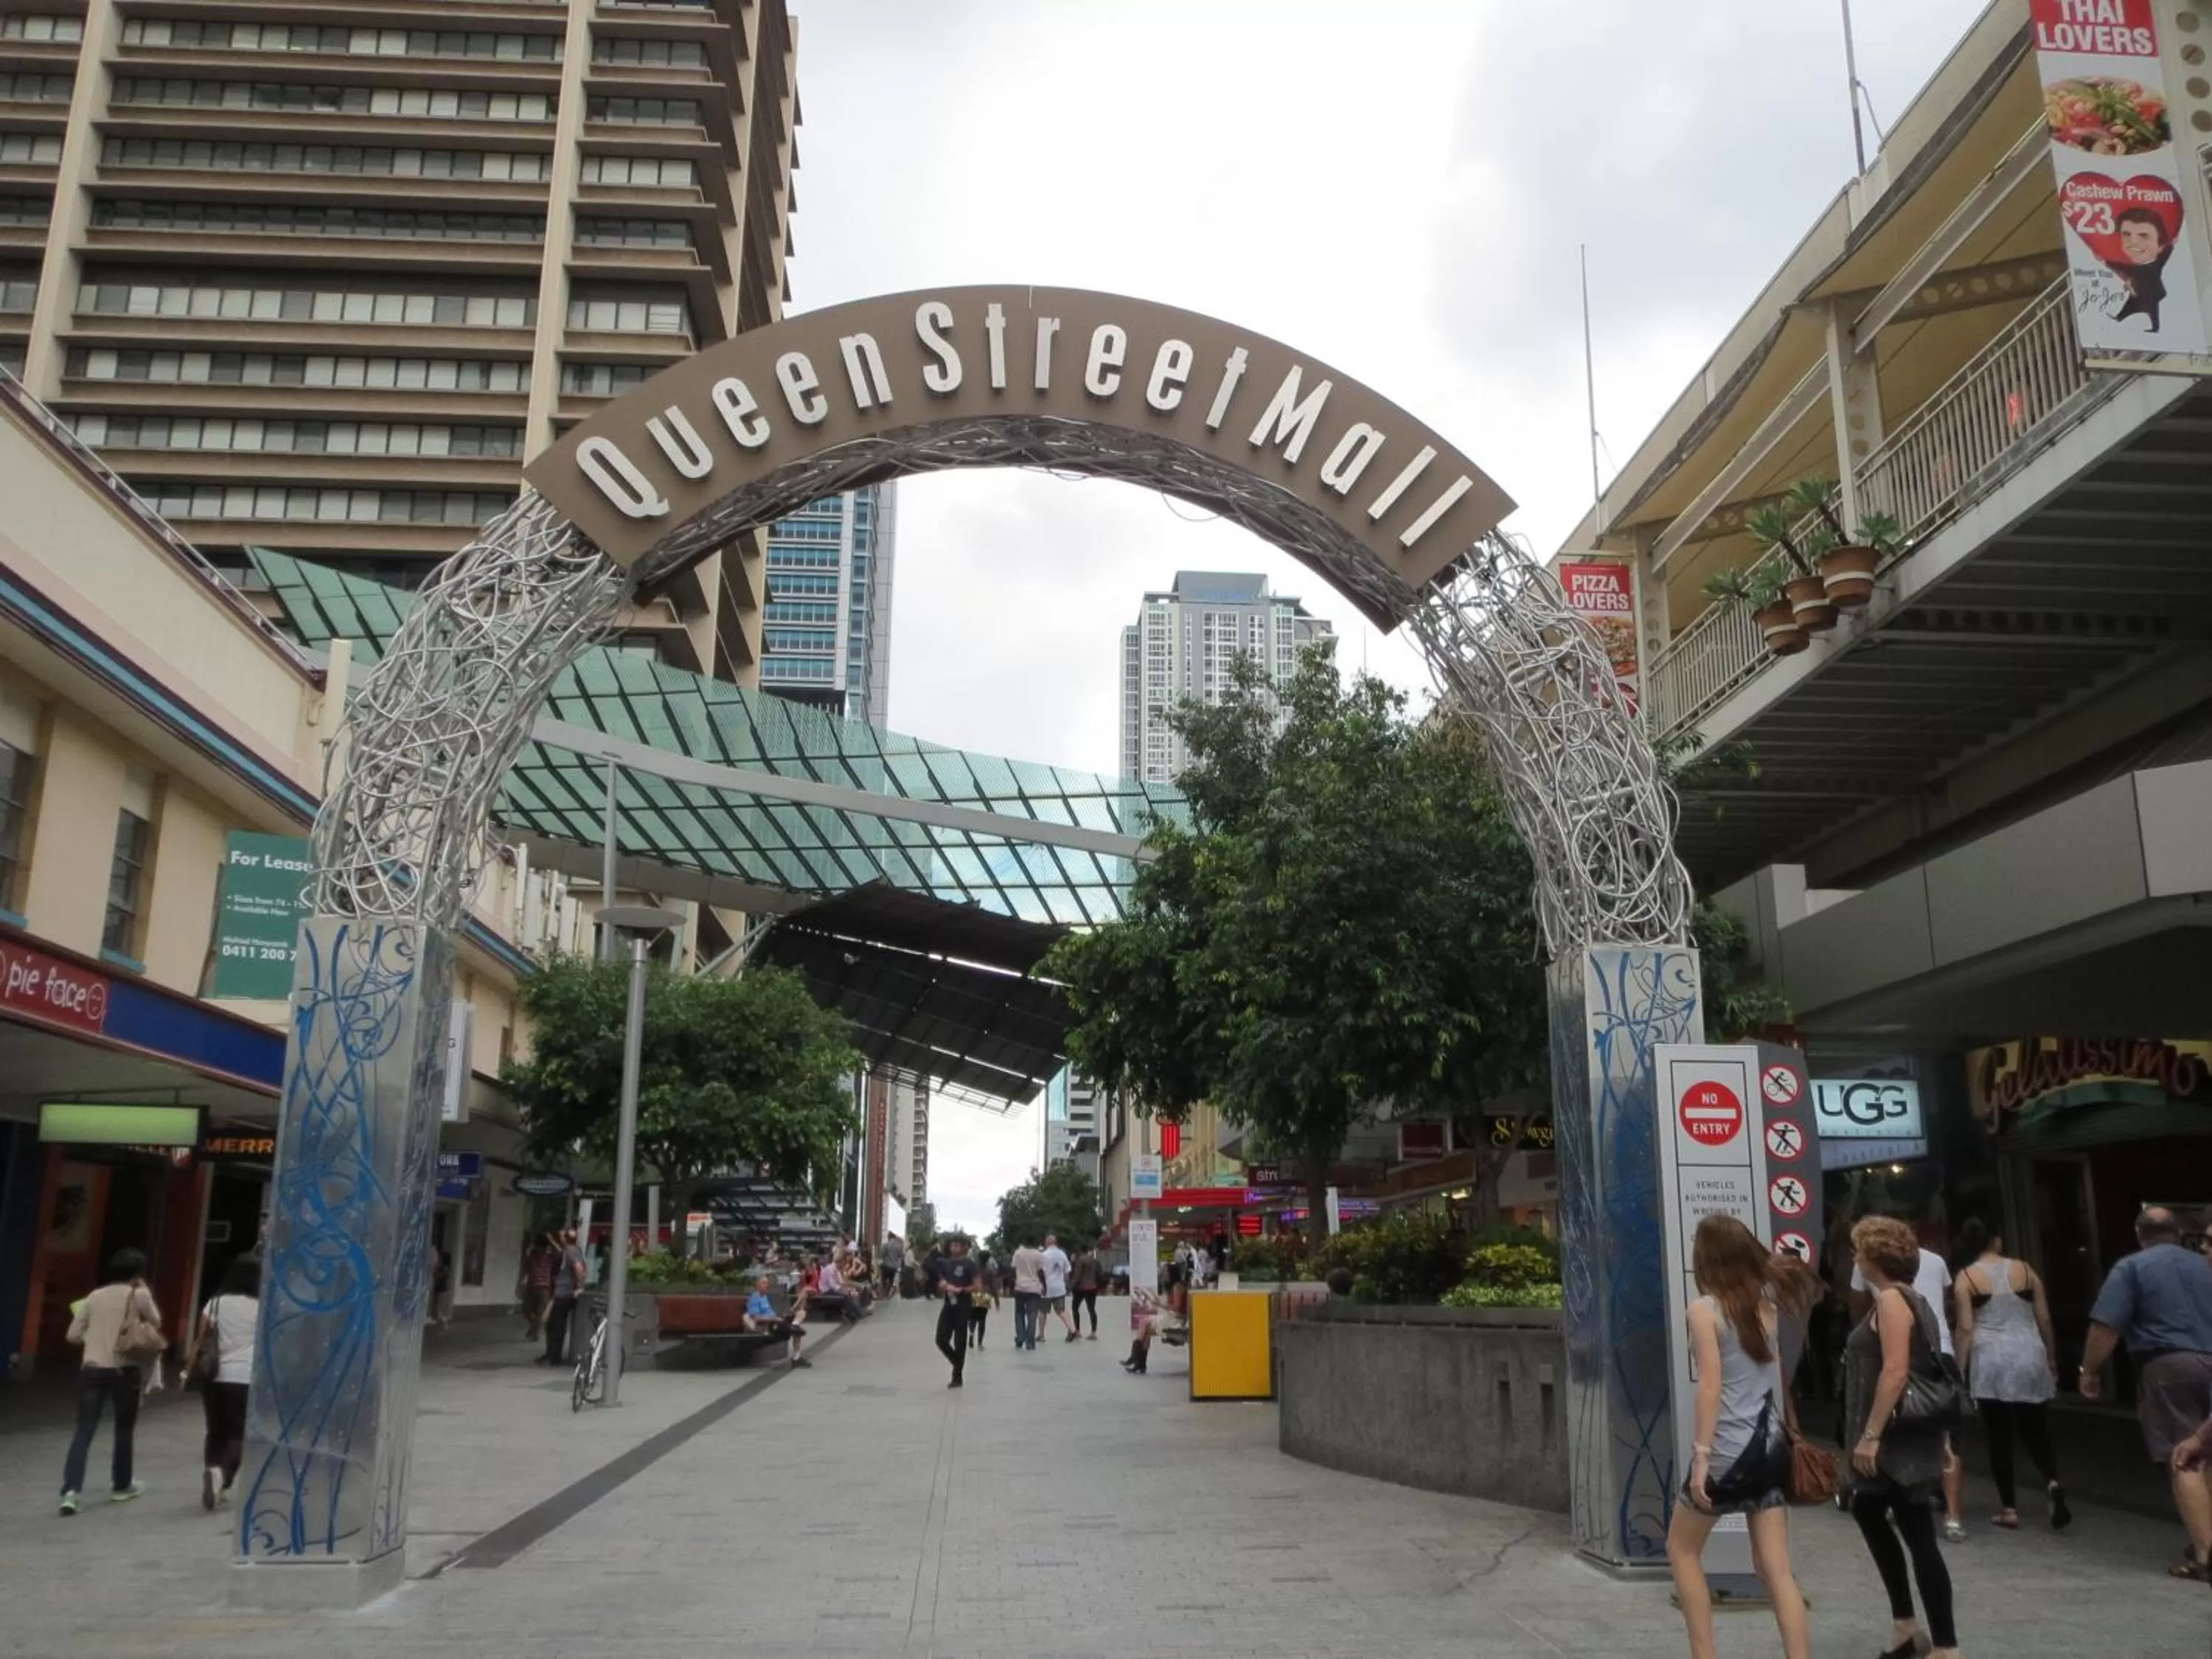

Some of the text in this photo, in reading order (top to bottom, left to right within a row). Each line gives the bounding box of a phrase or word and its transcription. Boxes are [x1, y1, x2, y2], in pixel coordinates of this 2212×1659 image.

[2056, 0, 2126, 24] THAI
[2037, 23, 2154, 55] LOVERS
[2065, 181, 2174, 204] Cashew Prawn
[2062, 200, 2115, 234] $23
[576, 301, 1473, 548] Queen Street Mall
[1571, 574, 1620, 592] PIZZA
[1565, 591, 1629, 610] LOVERS
[231, 850, 260, 866] For
[222, 945, 254, 958] 0411
[260, 947, 285, 960] 200
[4, 953, 87, 1013] pie face
[1701, 1093, 1718, 1105] NO
[1817, 1082, 1909, 1125] UGG
[1692, 1123, 1731, 1135] ENTRY
[1696, 1181, 1735, 1189] VEHICLES
[1739, 1194, 1748, 1203] IN
